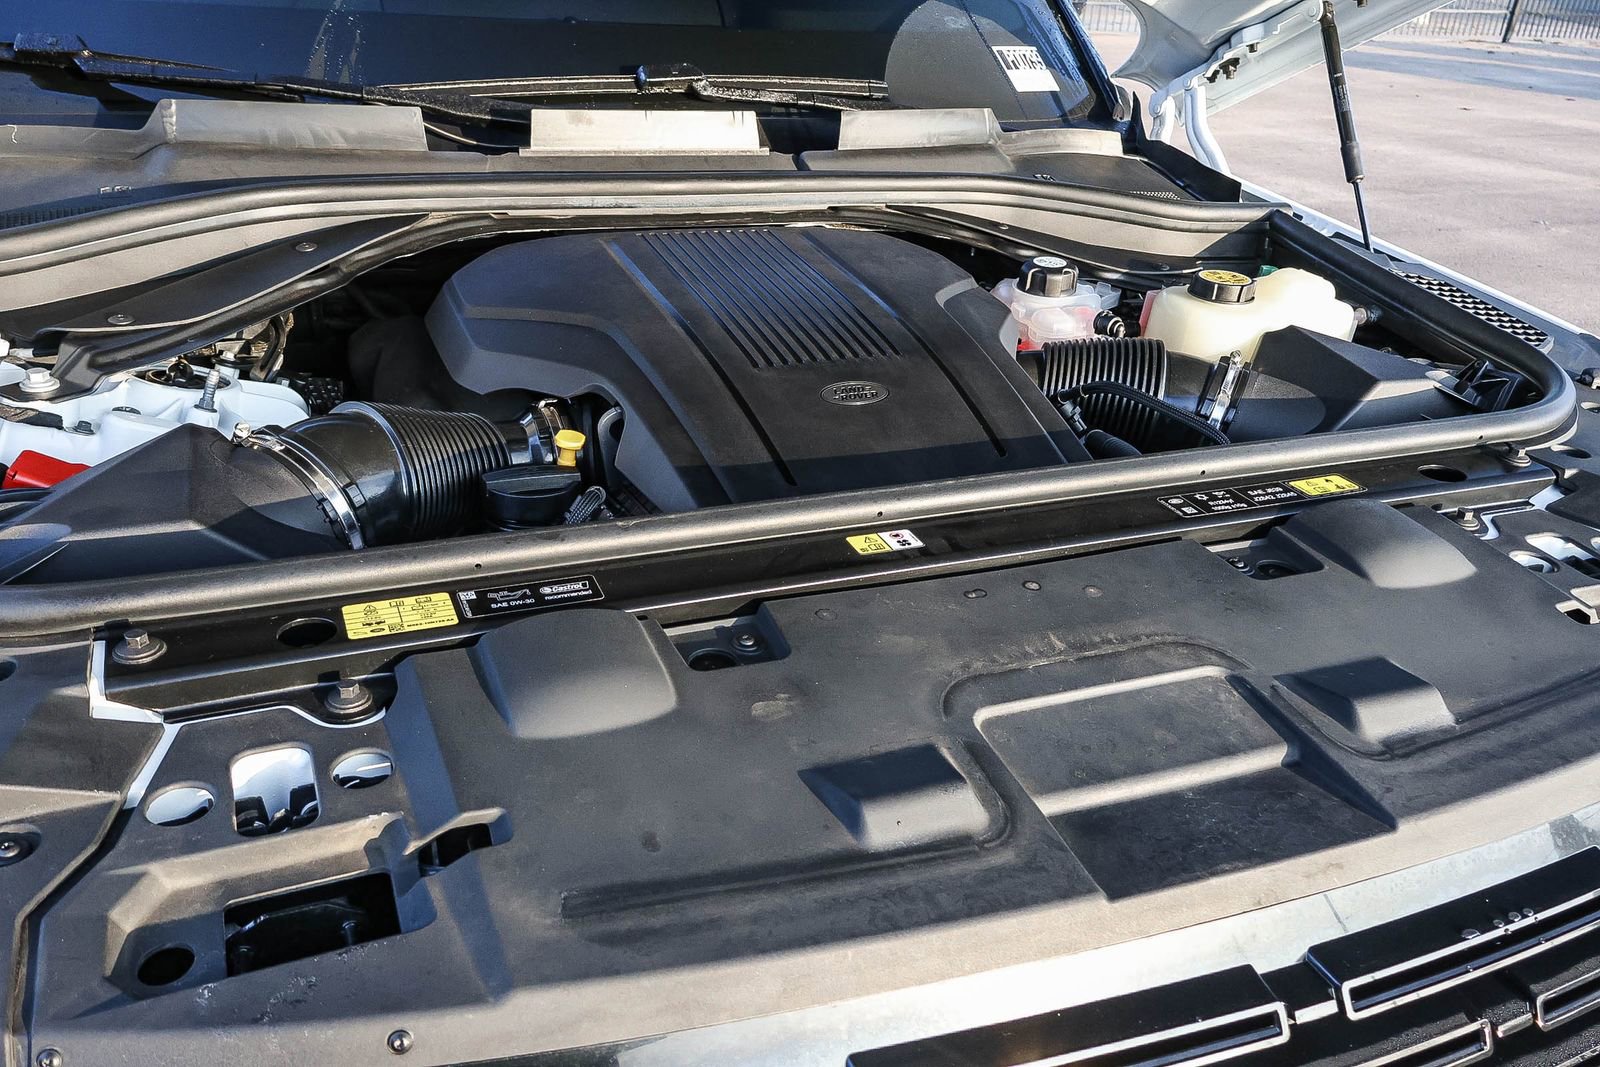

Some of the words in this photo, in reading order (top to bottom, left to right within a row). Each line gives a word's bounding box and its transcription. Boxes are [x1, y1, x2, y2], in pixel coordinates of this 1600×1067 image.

[833, 385, 865, 395] LAND
[840, 391, 879, 401] ROVER
[552, 582, 583, 592] Castrol
[544, 589, 593, 600] recommended
[491, 601, 509, 609] SAE
[509, 598, 536, 606] 0W-30
